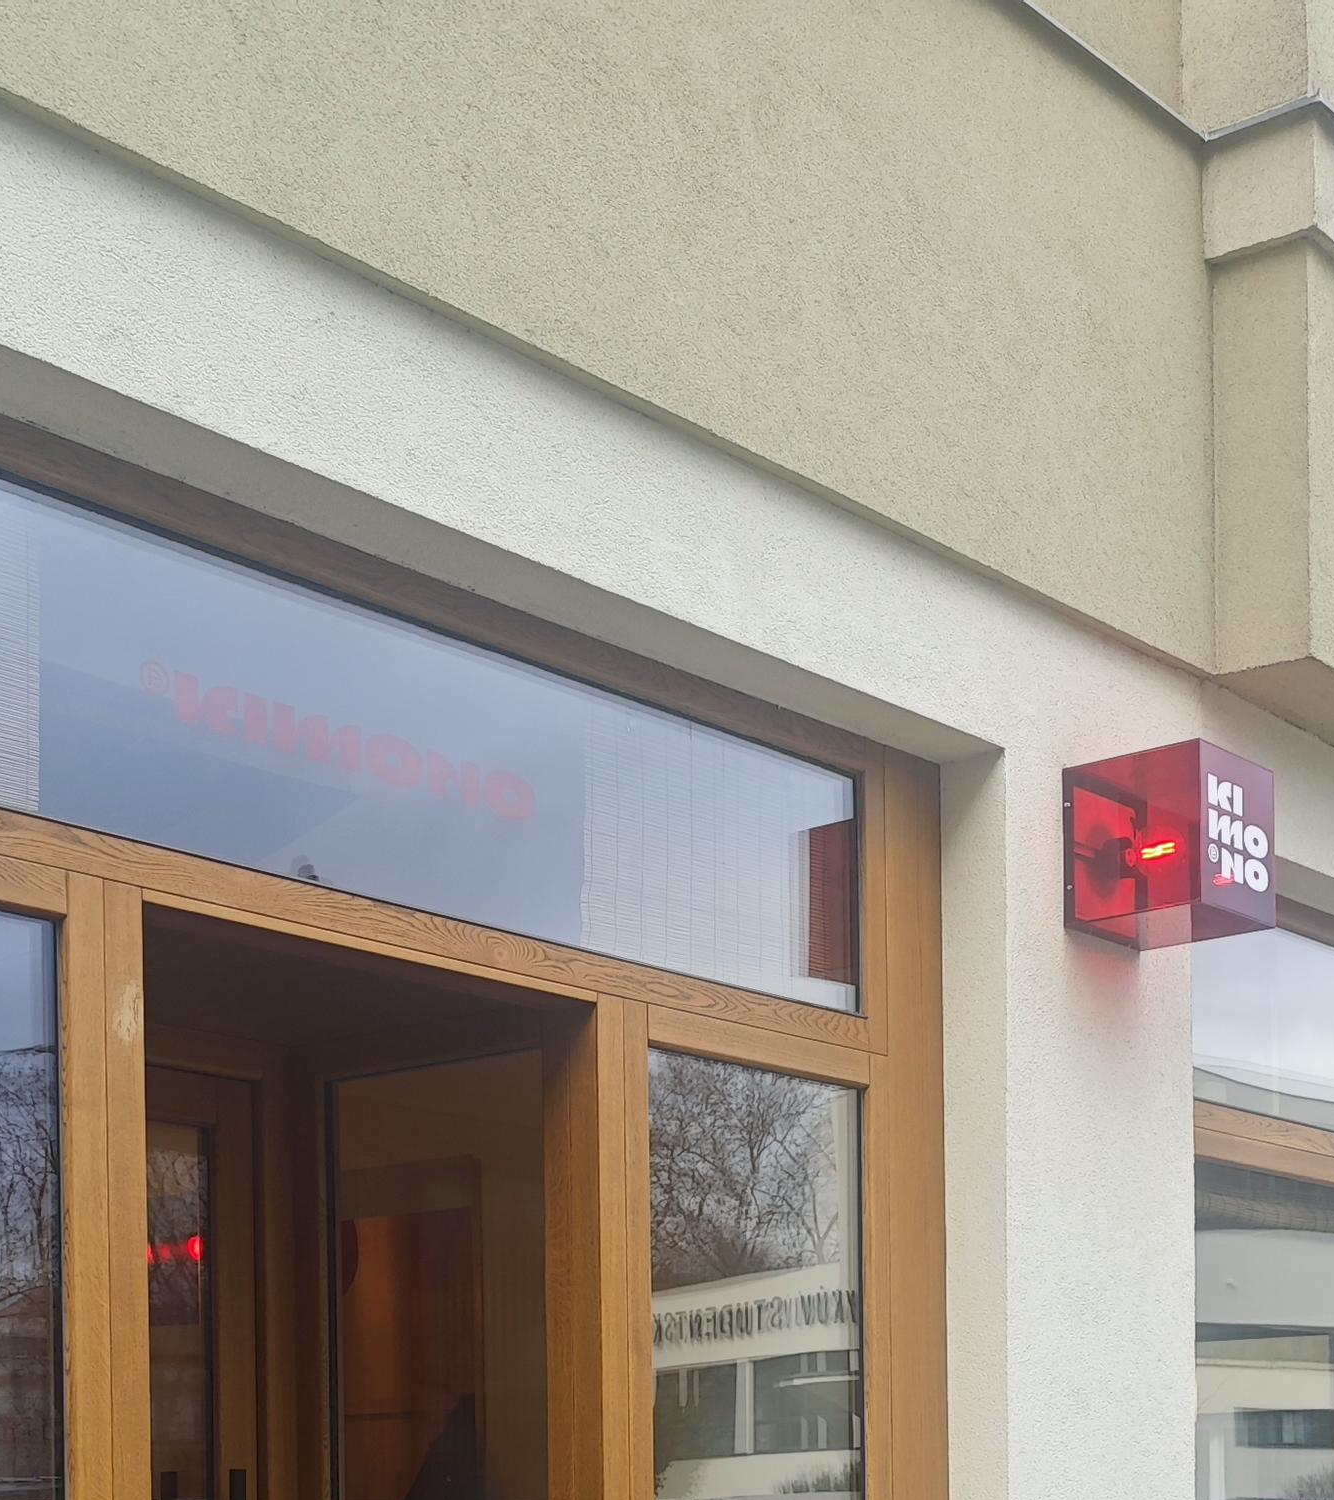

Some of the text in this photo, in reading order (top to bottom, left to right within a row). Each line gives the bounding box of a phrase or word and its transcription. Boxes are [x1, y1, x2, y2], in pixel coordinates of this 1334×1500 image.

[174, 671, 537, 822] KIMONO
[1207, 773, 1243, 817] KI
[1208, 808, 1269, 859] MO
[1221, 847, 1269, 893] NO
